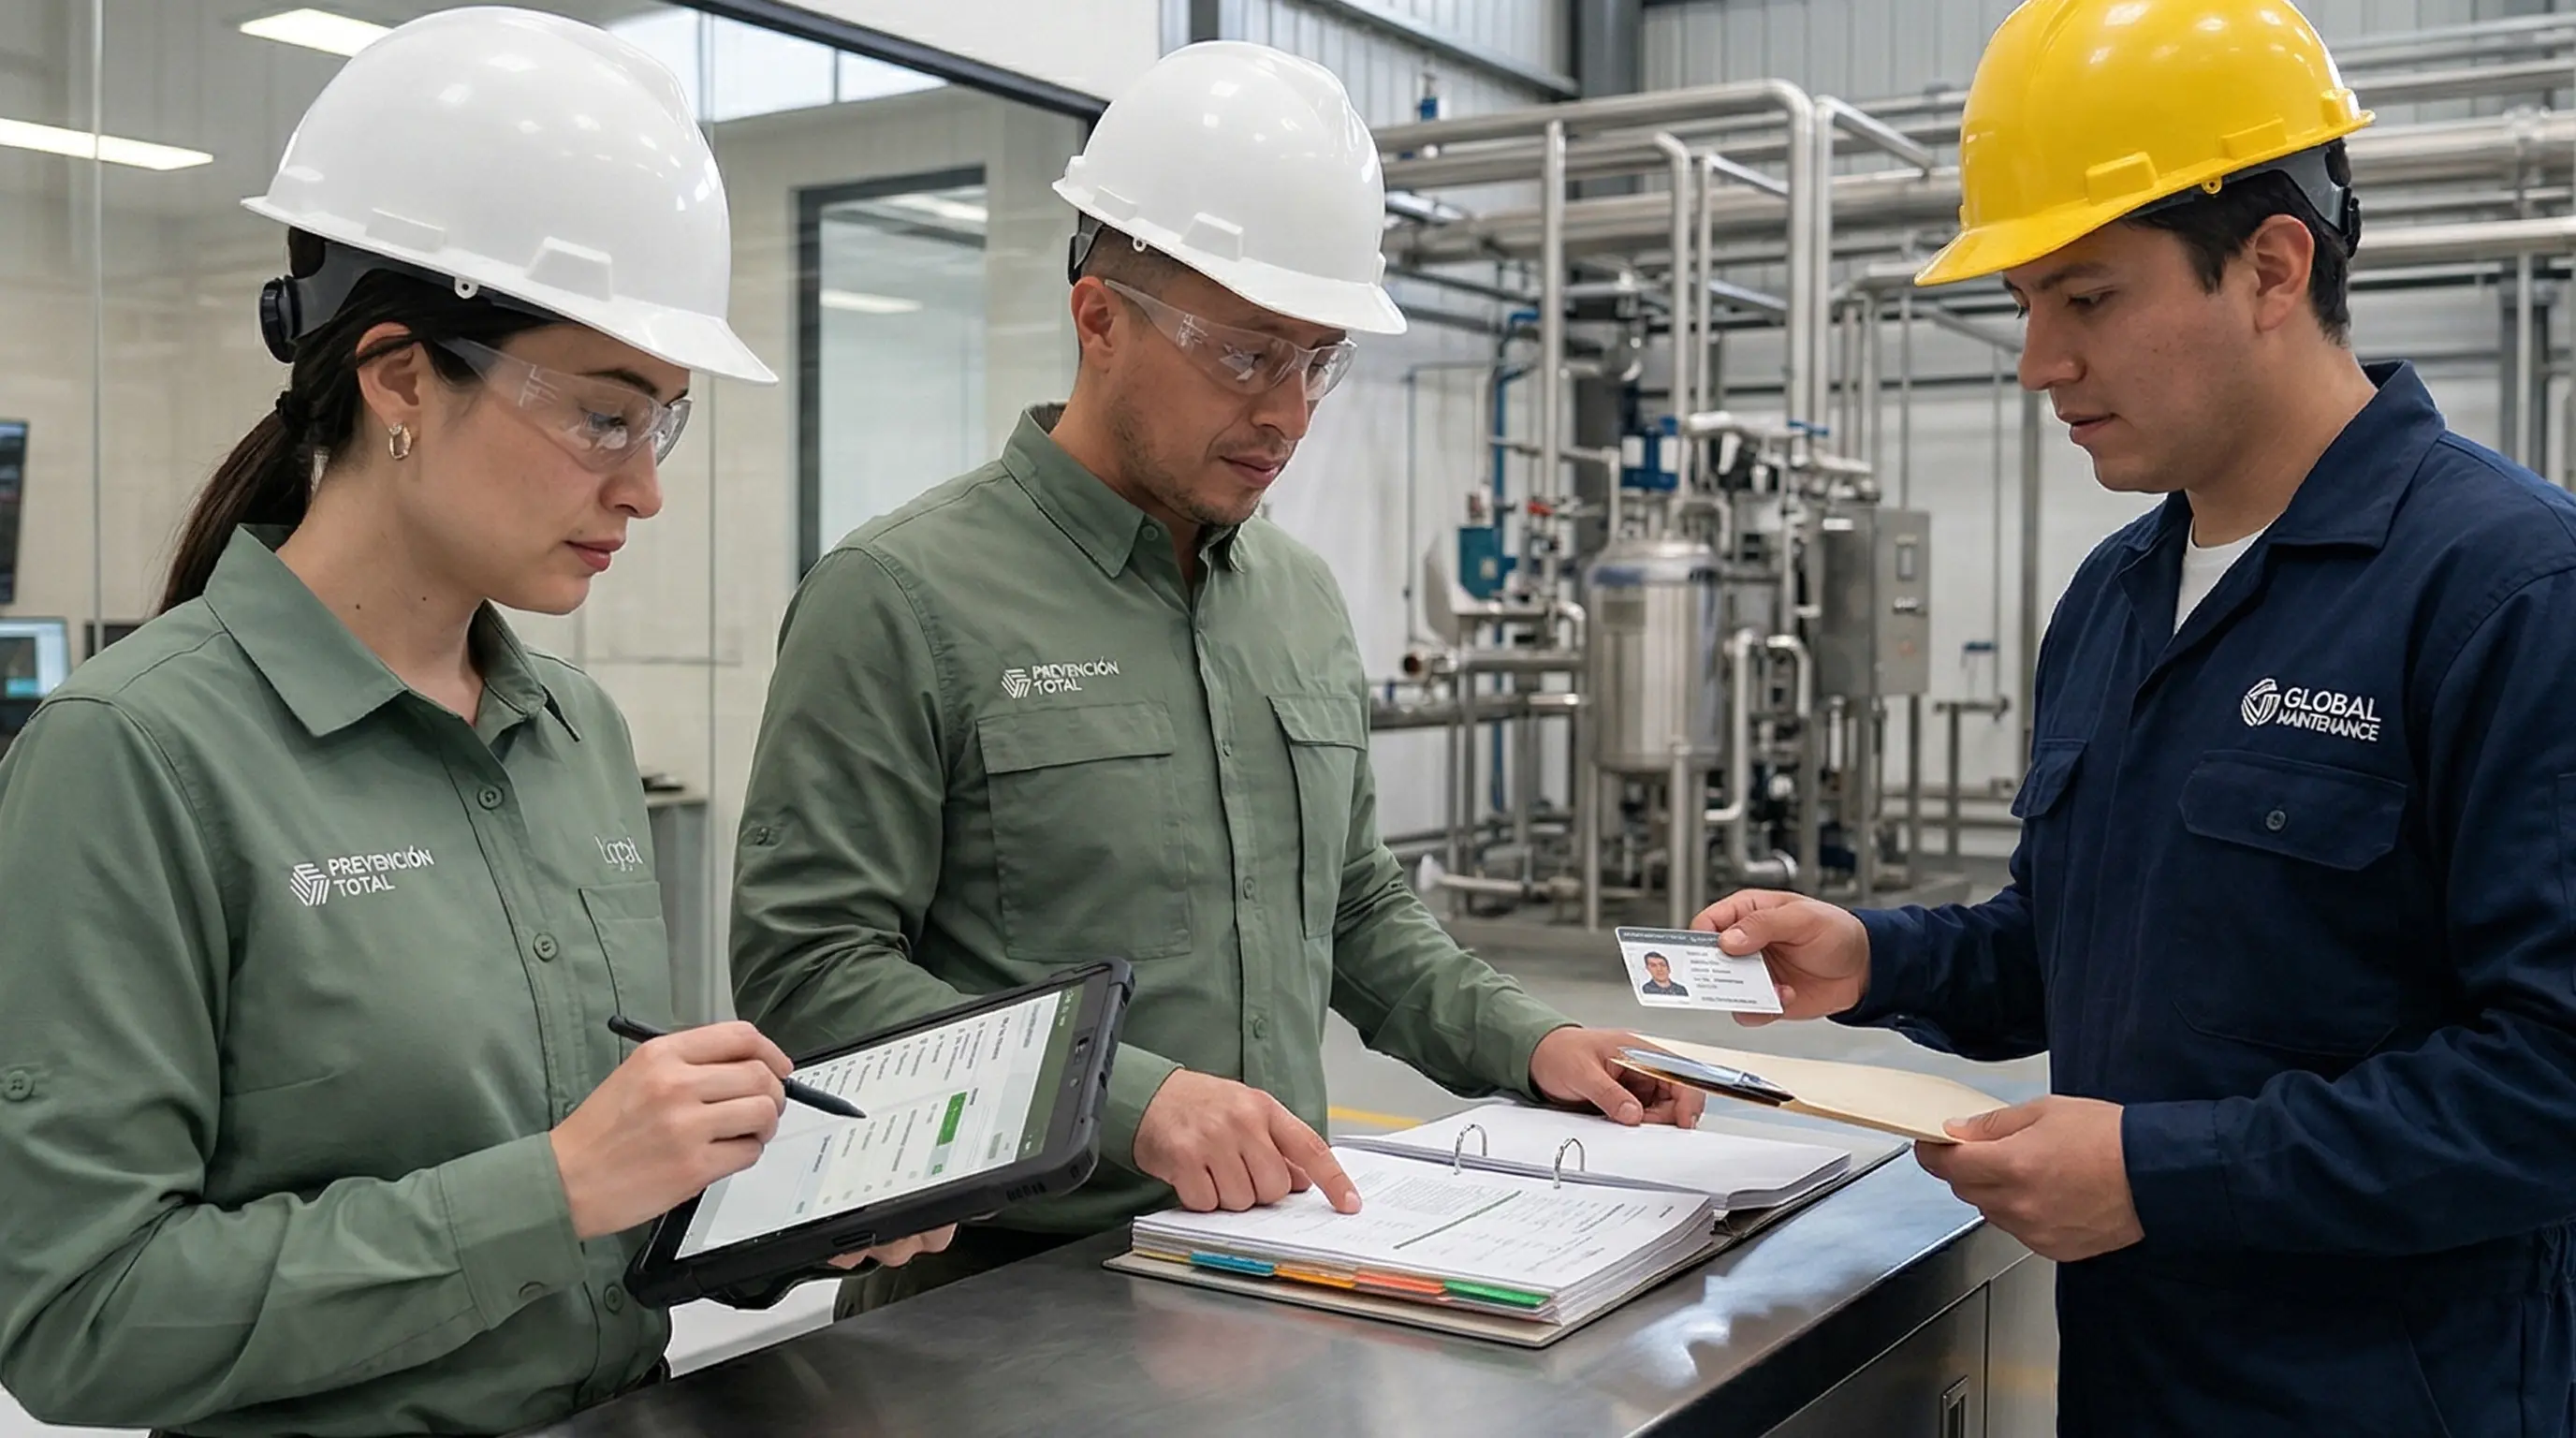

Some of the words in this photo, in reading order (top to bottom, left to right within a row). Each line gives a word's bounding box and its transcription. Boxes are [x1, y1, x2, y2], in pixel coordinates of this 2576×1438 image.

[1033, 677, 1082, 696] TOTAL
[2284, 686, 2381, 722] GLOBAL
[333, 873, 396, 897] TOTAL
